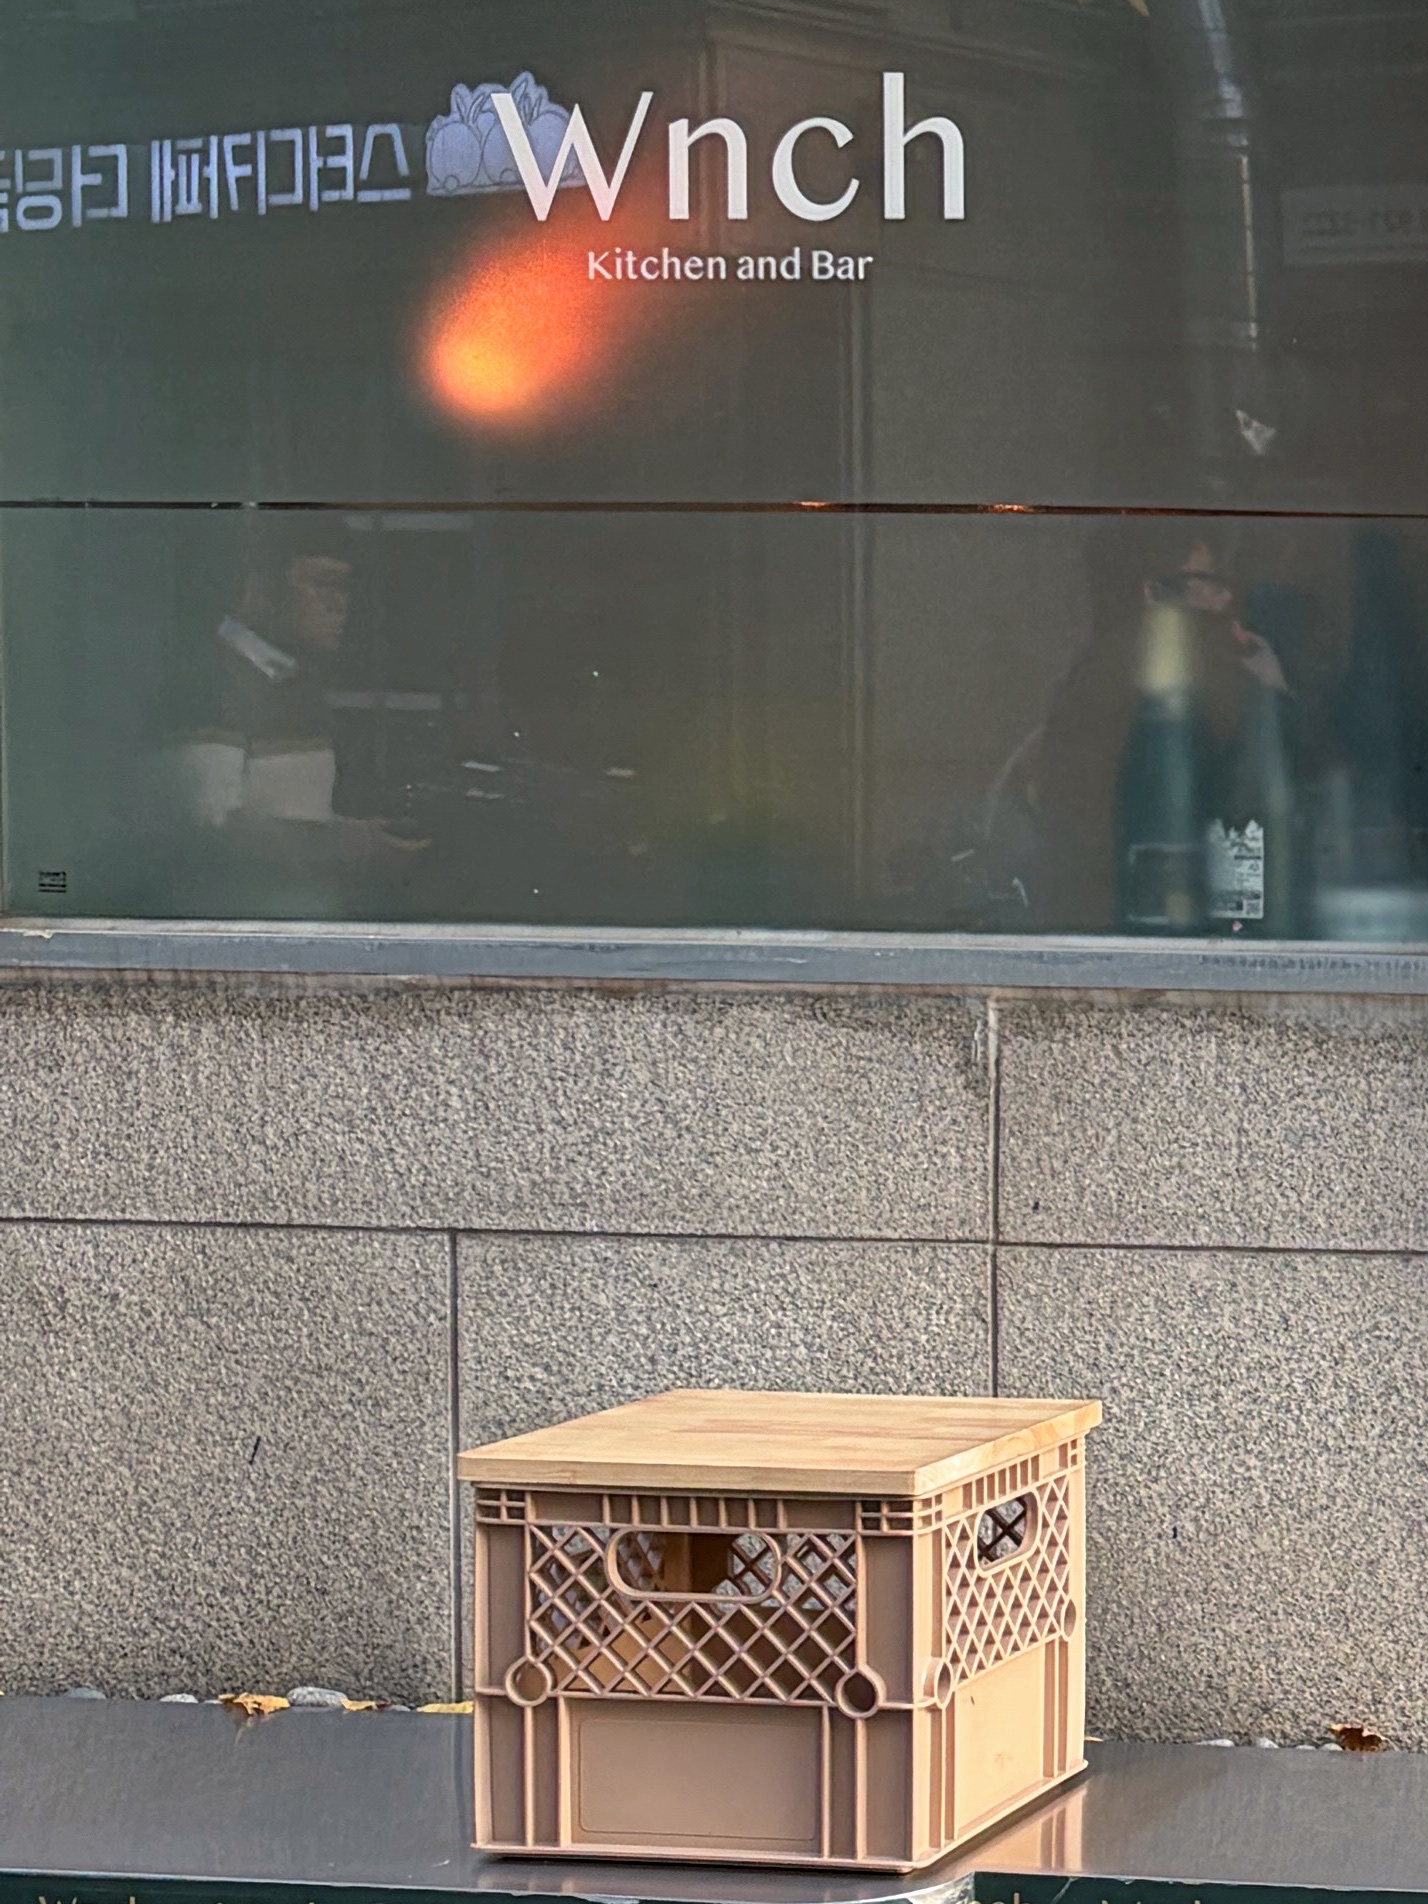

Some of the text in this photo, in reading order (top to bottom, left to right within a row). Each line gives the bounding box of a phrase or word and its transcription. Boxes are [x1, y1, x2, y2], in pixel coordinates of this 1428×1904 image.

[491, 71, 966, 222] Wnch
[587, 248, 872, 281] Kitchen and Bar
